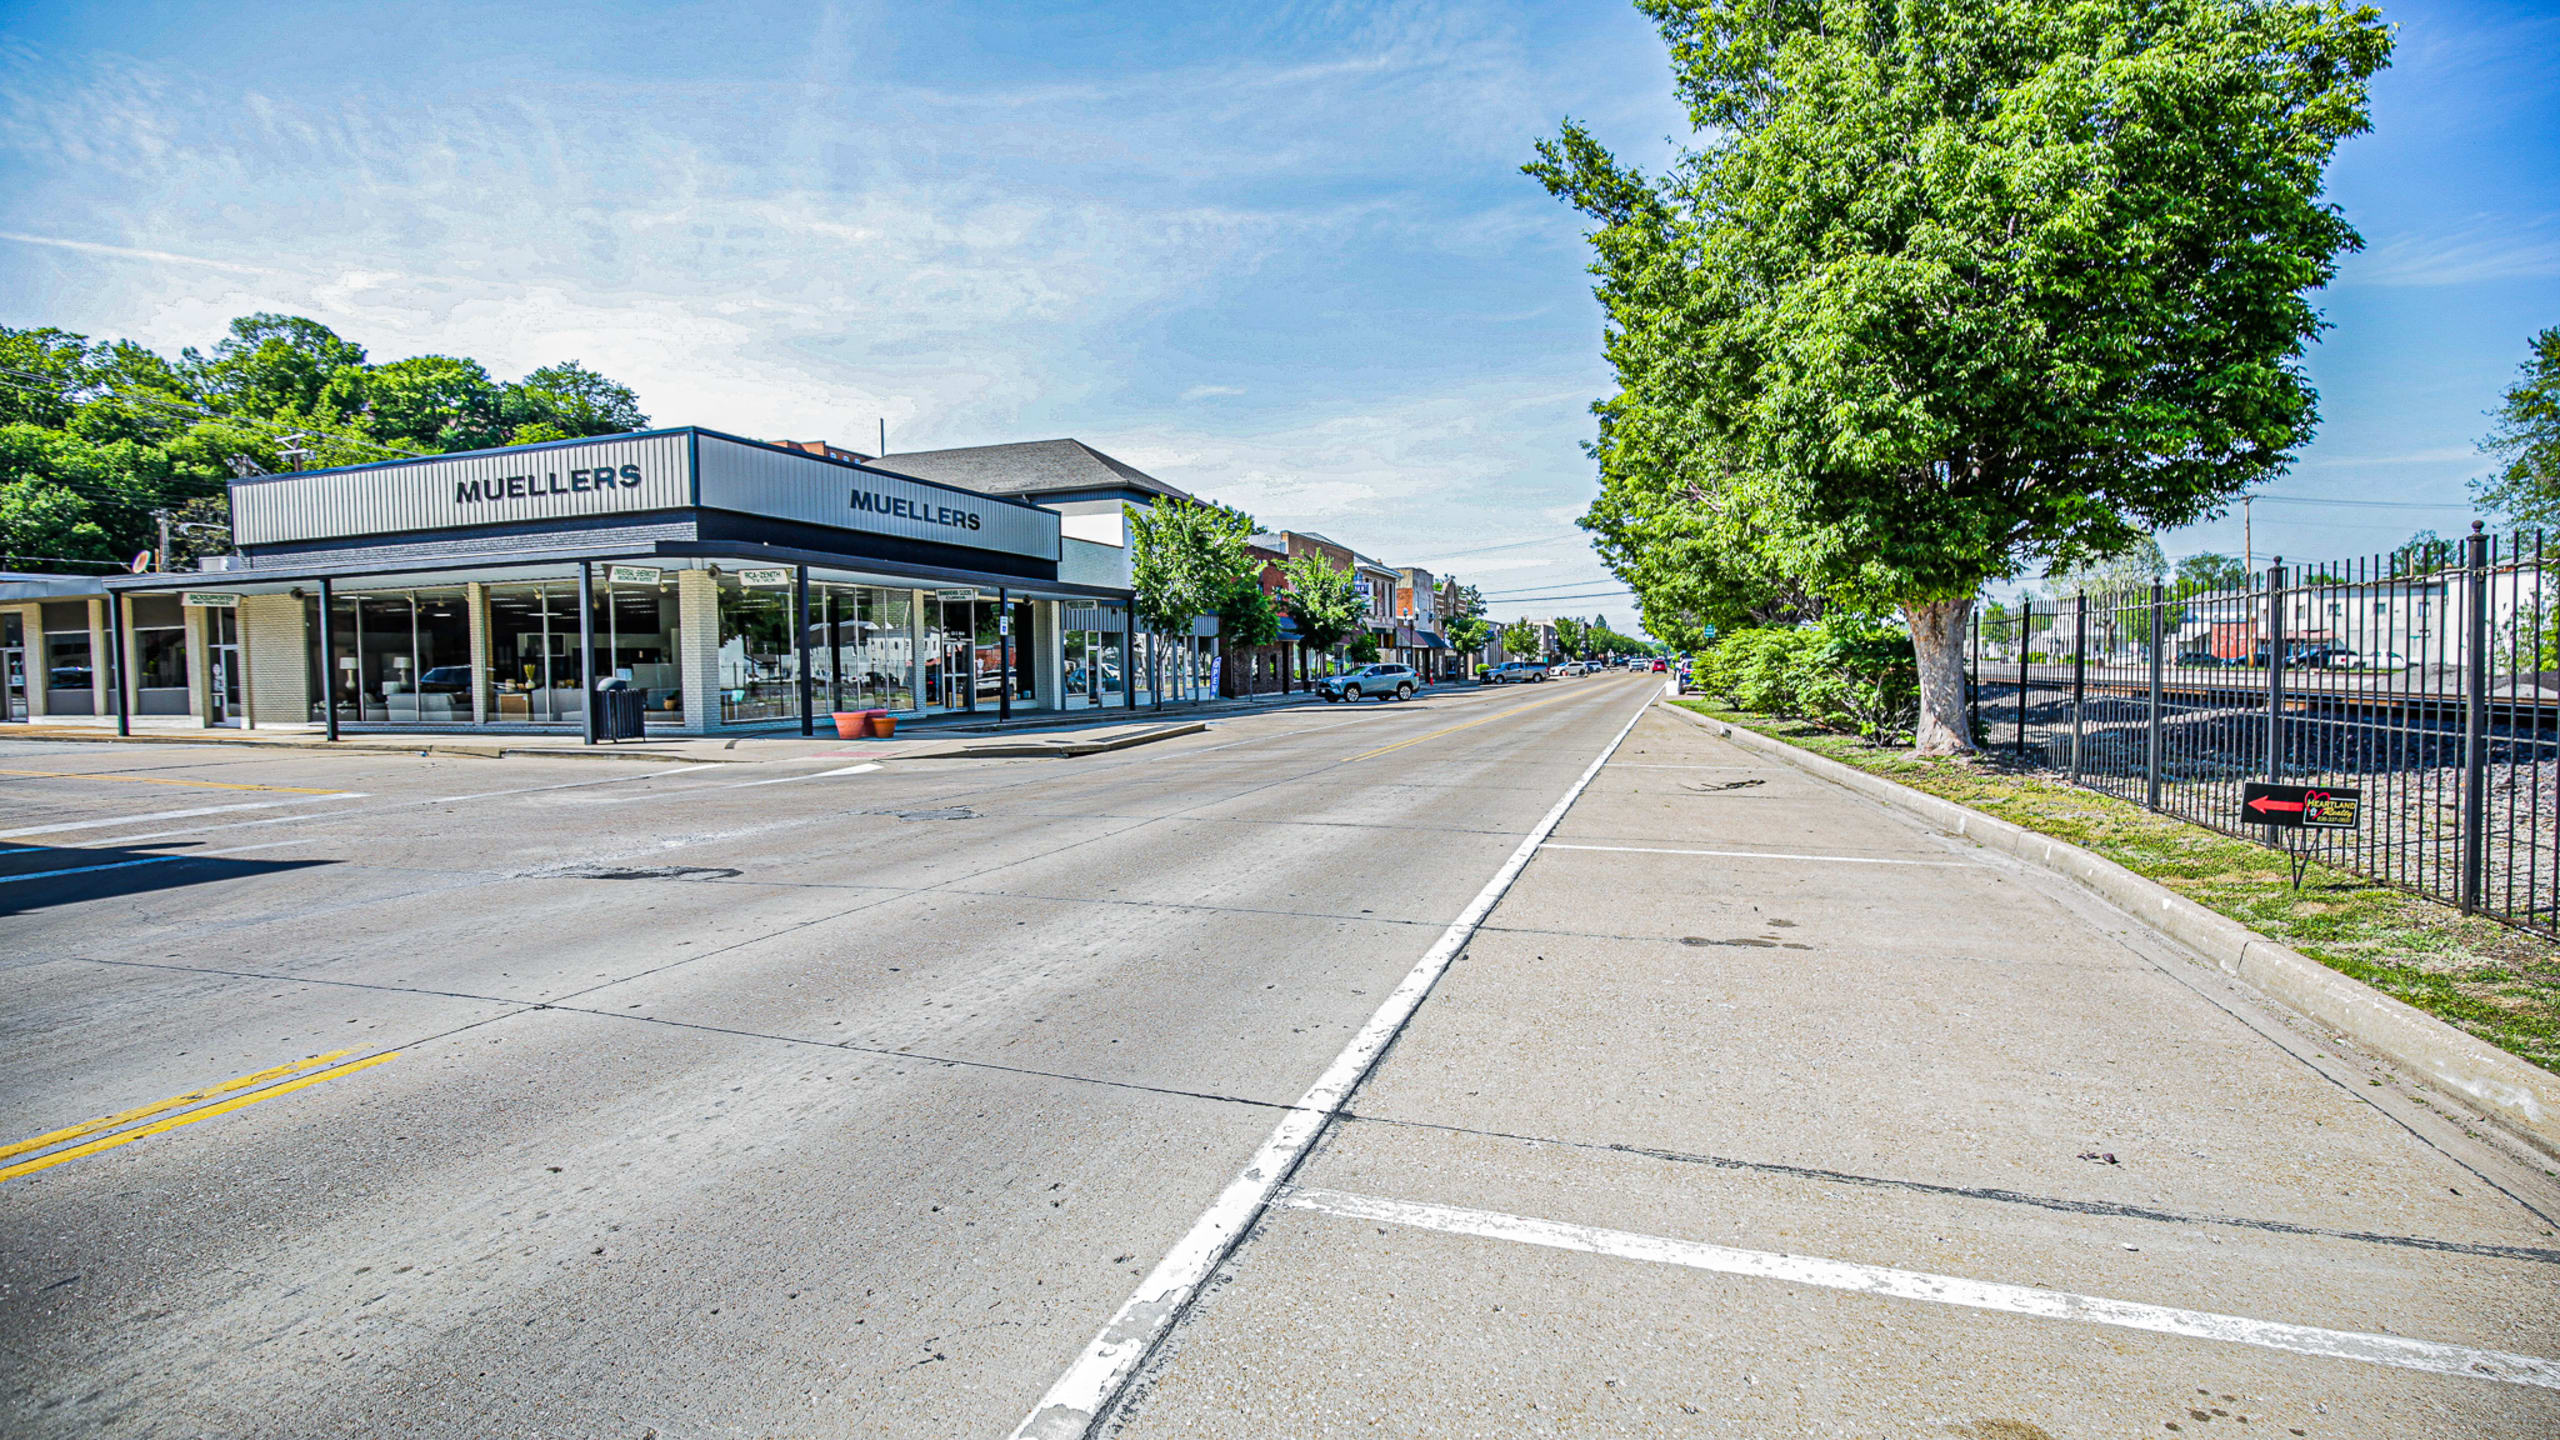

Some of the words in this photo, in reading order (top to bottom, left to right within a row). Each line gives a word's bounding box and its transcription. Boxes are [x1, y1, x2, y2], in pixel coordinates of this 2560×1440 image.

[456, 464, 642, 503] MUELLERS
[850, 489, 981, 530] MUELLERS
[2307, 799, 2357, 810] HEARTLAND
[2322, 808, 2353, 817] Realty
